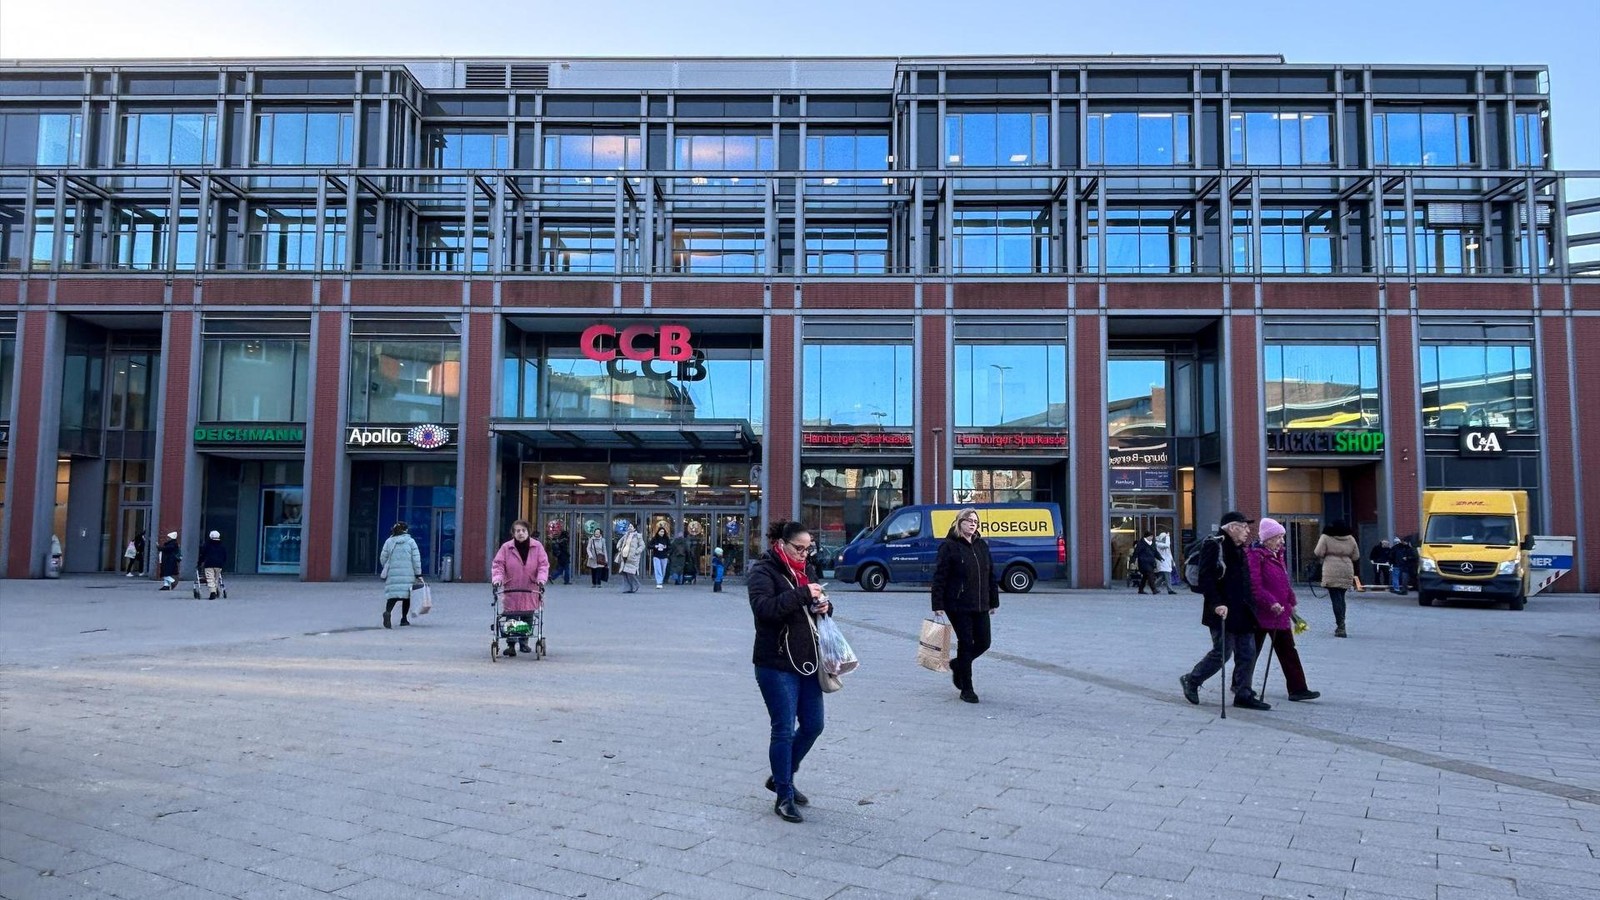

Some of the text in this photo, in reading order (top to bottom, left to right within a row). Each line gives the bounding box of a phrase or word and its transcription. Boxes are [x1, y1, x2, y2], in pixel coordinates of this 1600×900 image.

[580, 324, 693, 361] CCB
[195, 427, 303, 442] DEICHMANN
[349, 428, 401, 446] Apollo
[804, 433, 912, 445] Hamburger Sparkasse
[956, 434, 1066, 446] Hamburger Sparkasse
[1466, 432, 1502, 451] C&A
[977, 521, 1048, 532] ROSEGUR
[1529, 557, 1553, 566] NER
